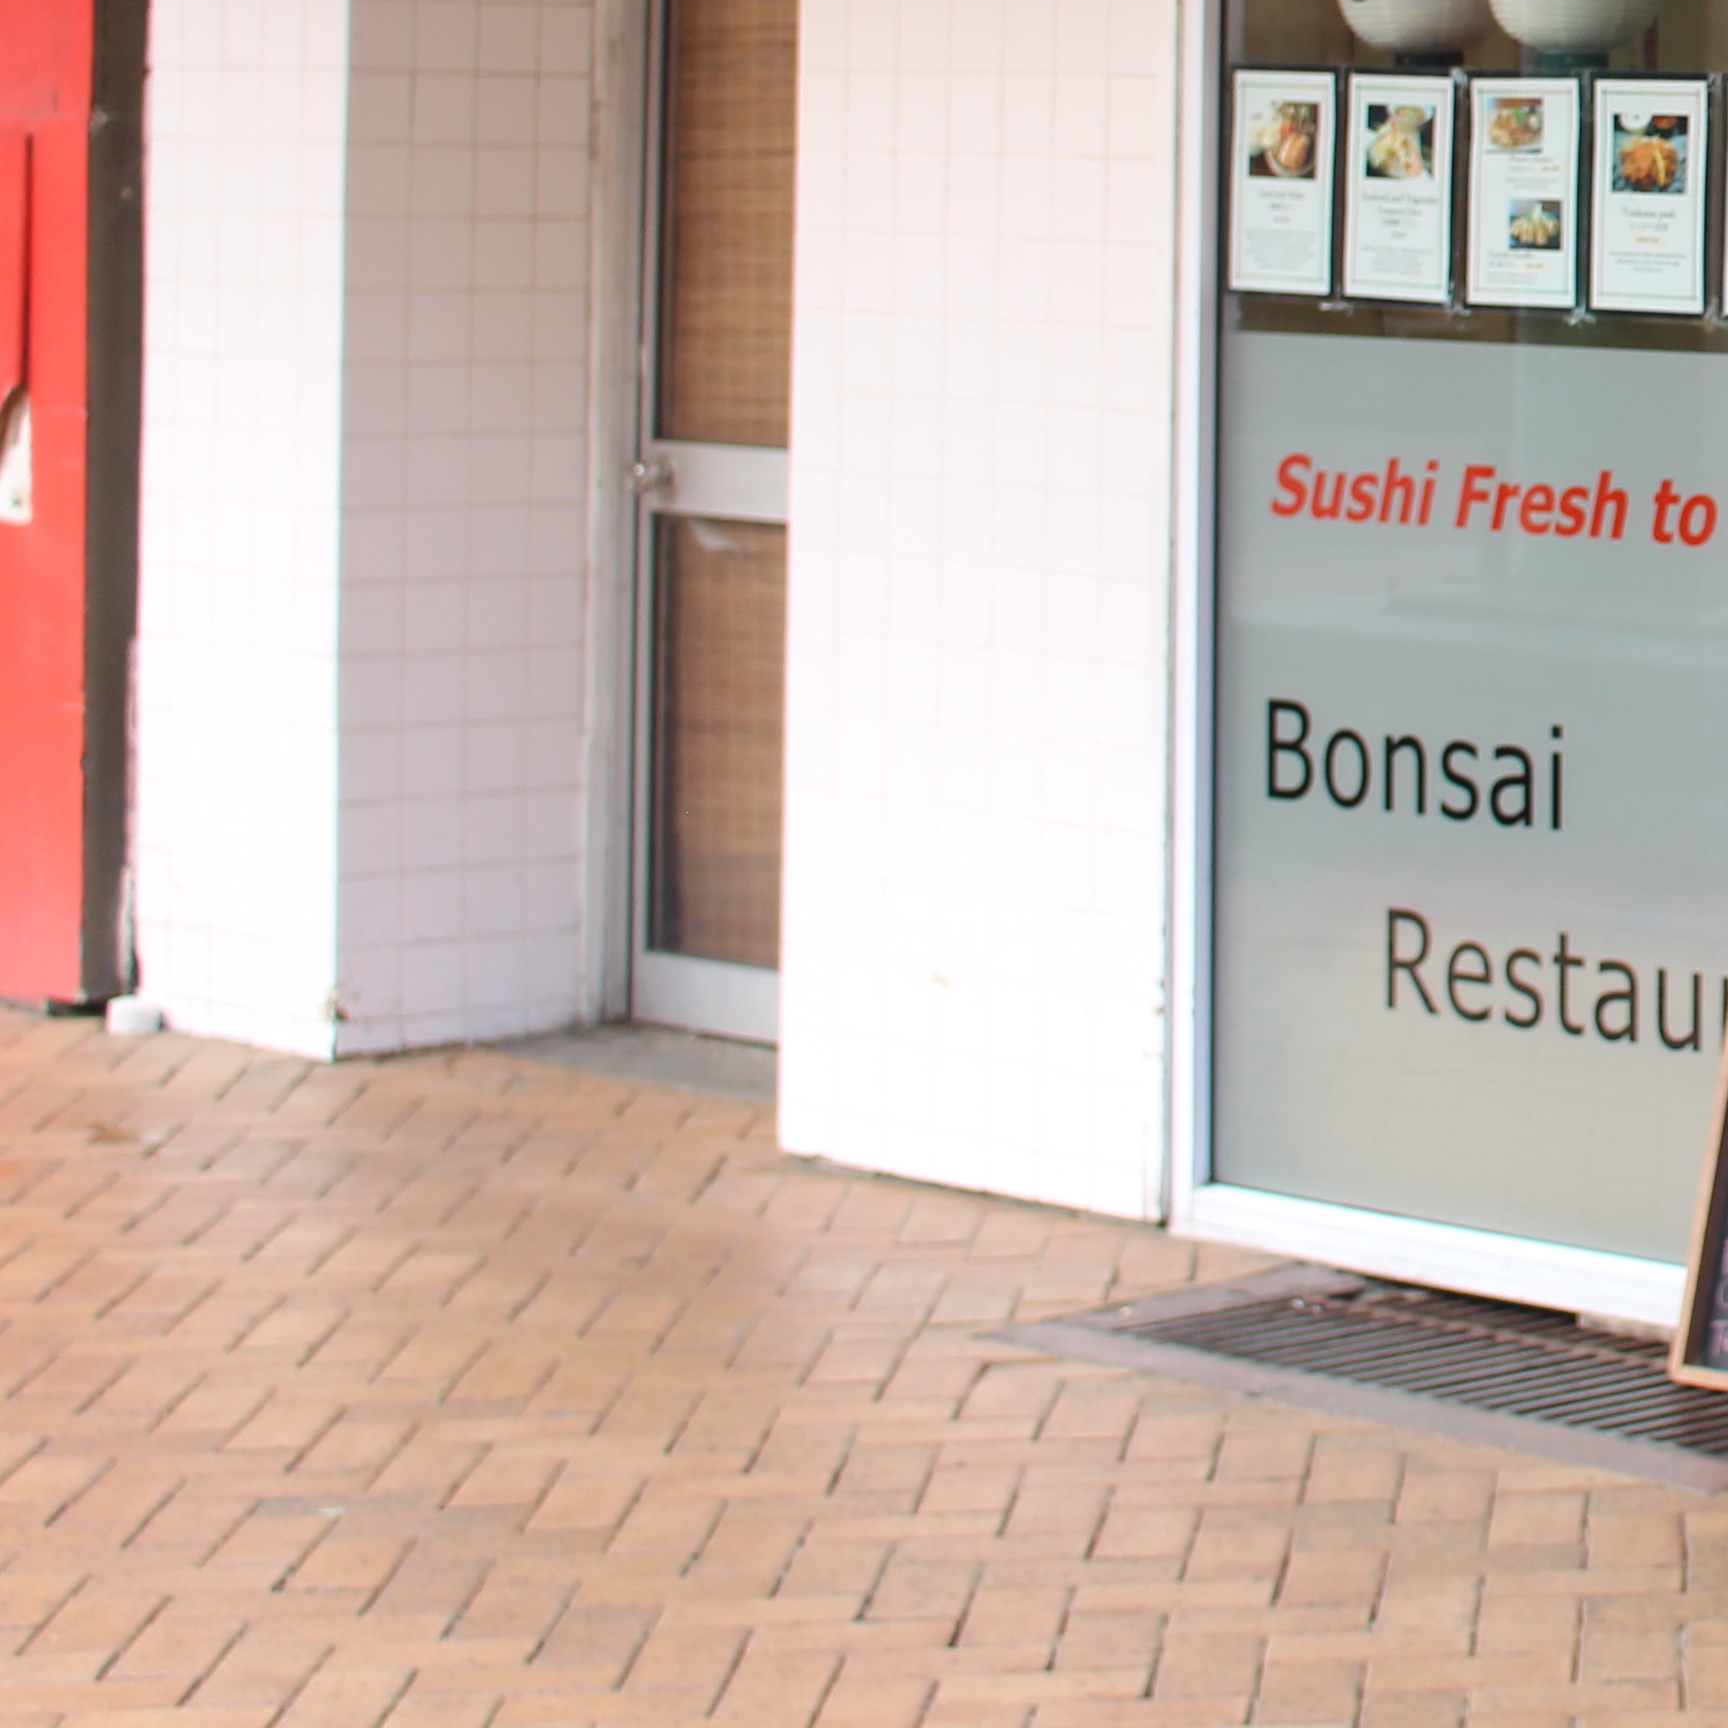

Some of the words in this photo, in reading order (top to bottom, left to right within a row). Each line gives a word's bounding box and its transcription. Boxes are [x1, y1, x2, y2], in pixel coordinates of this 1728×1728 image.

[1270, 453, 1440, 527] Sushi
[1455, 465, 1630, 541] Fresh
[1651, 479, 1718, 548] to
[1265, 698, 1564, 831] Bonsai
